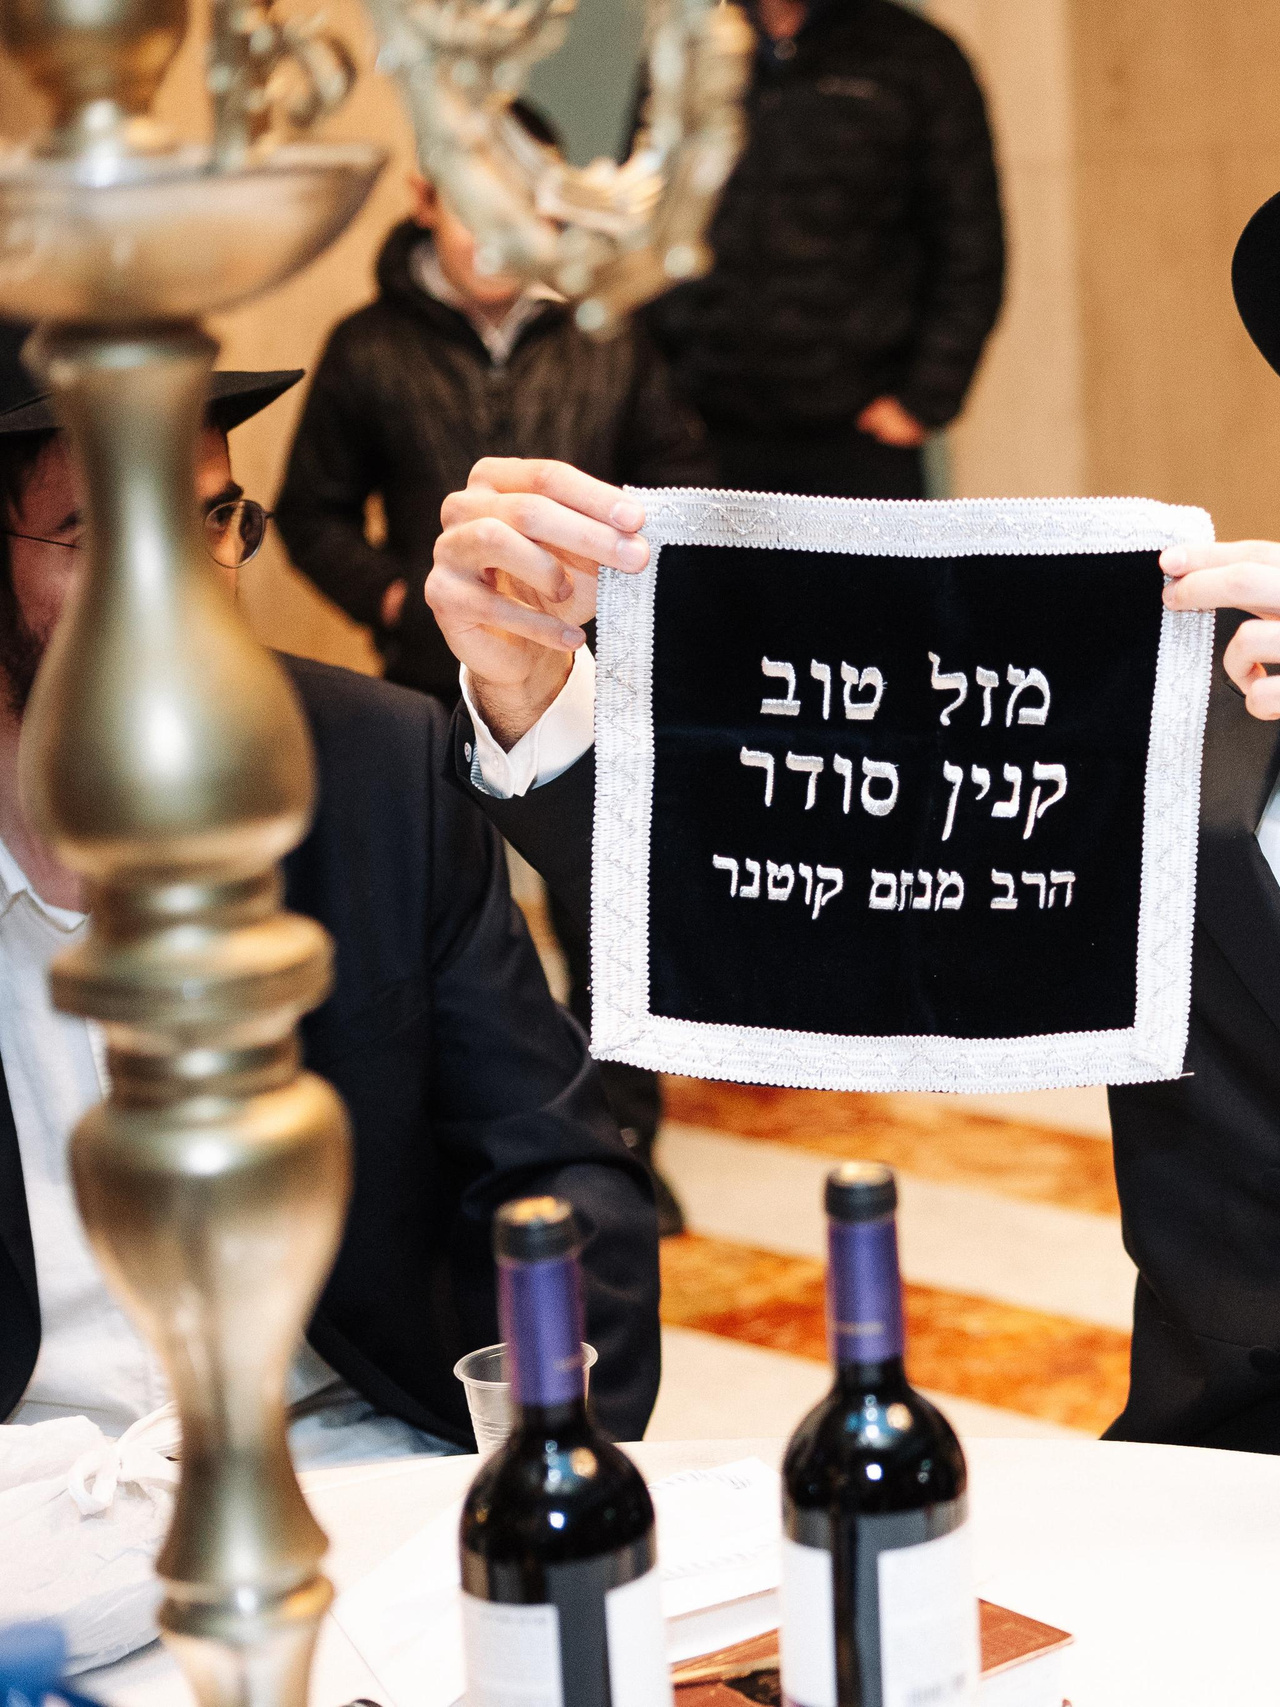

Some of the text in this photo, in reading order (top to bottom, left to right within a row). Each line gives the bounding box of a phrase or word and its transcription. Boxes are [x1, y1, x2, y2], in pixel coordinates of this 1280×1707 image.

[760, 651, 1051, 728] מזל טוב
[739, 746, 1068, 842] קנין סודר
[712, 854, 844, 920] קוטנר
[990, 868, 1077, 910] הרב
